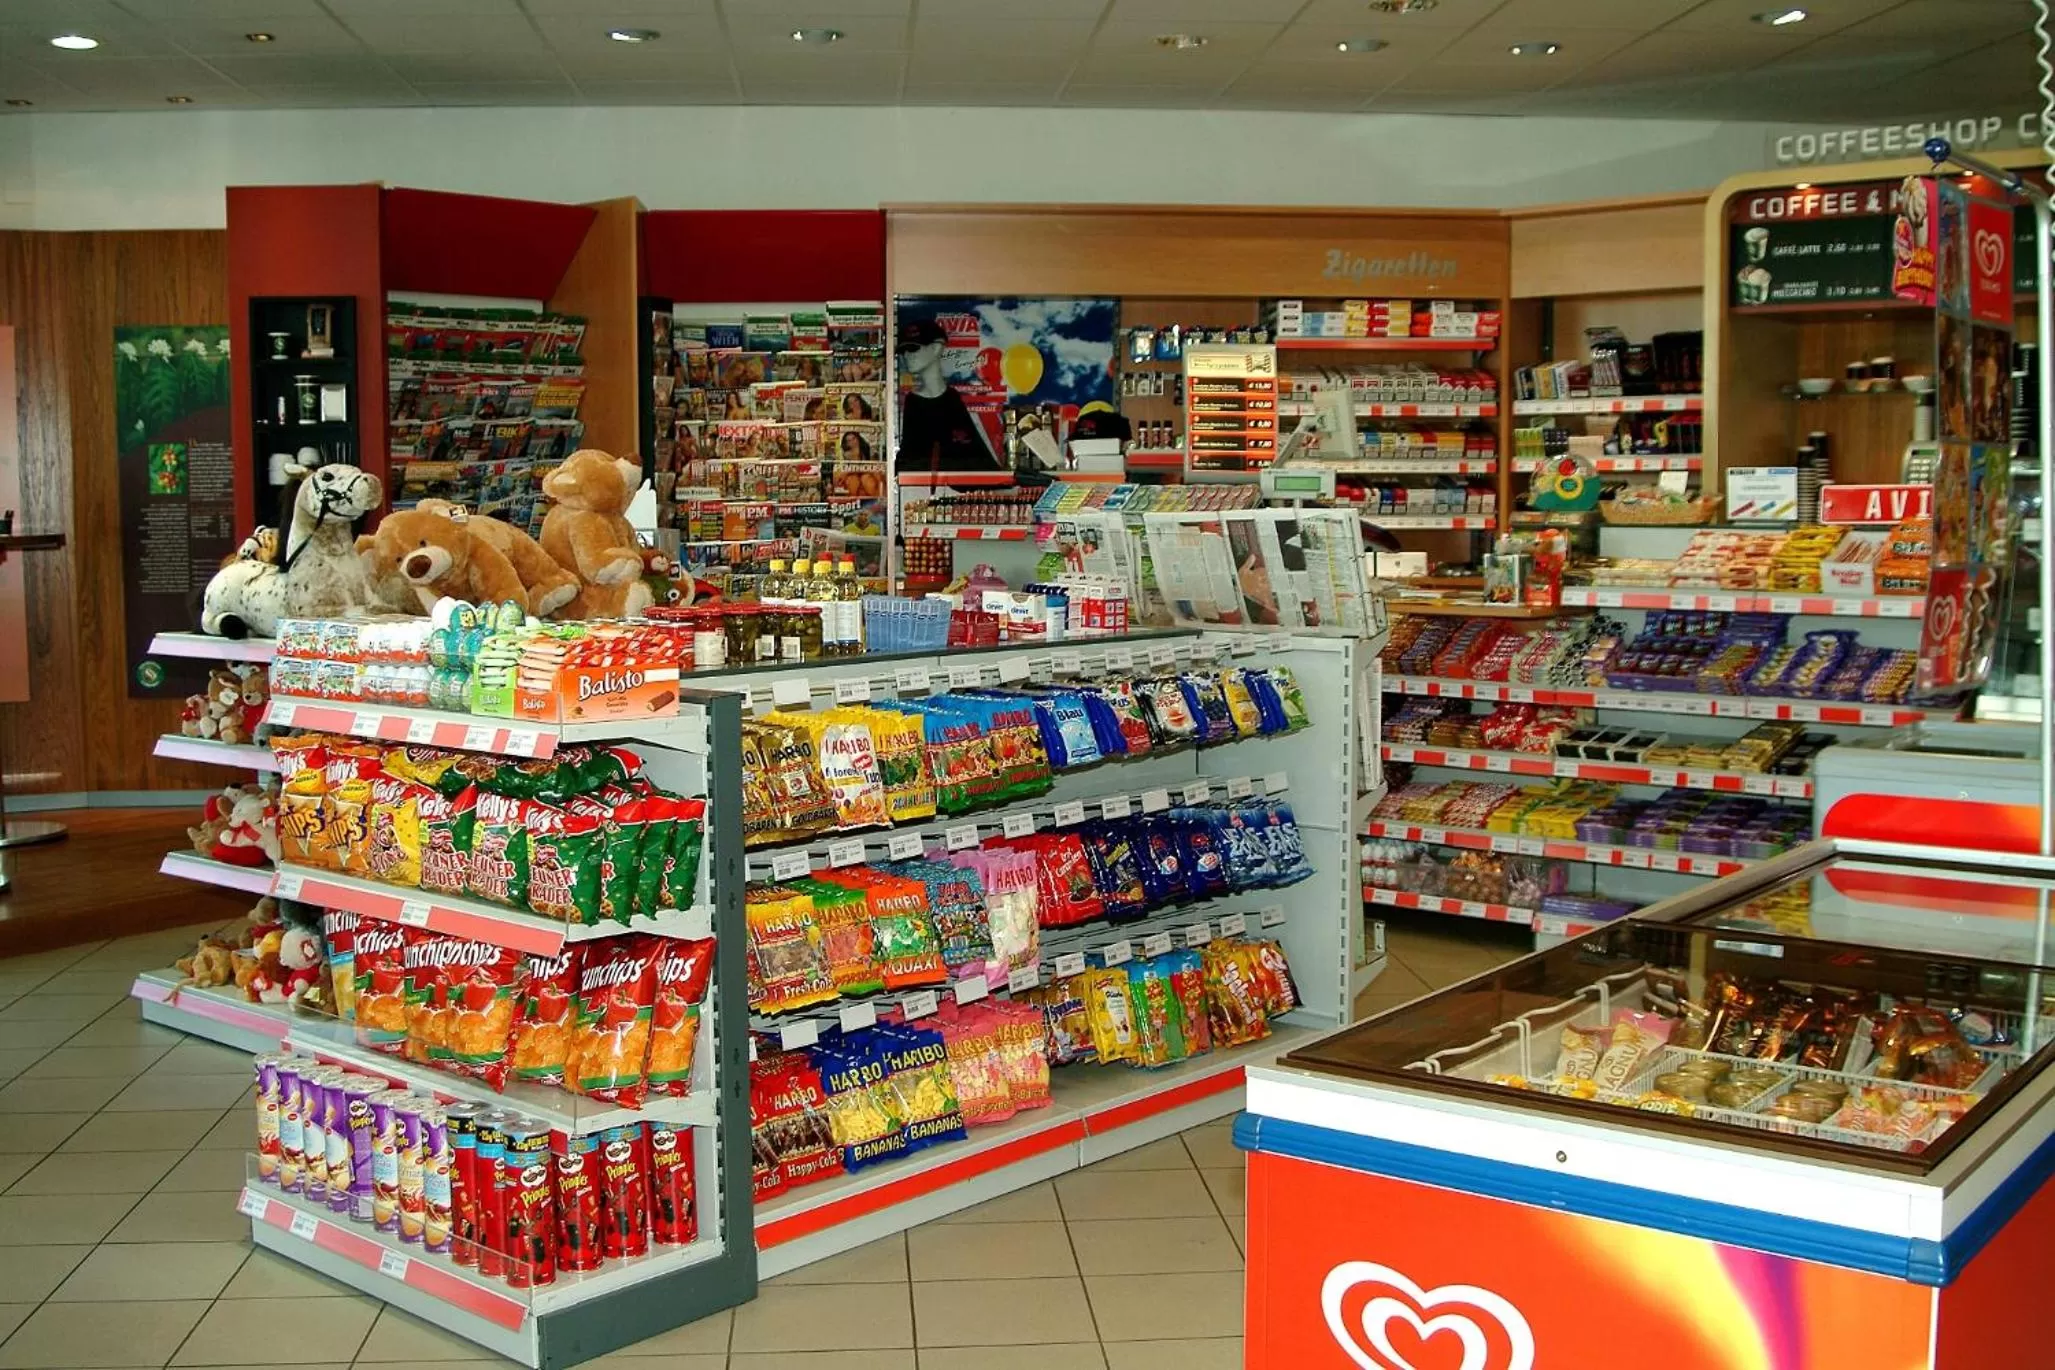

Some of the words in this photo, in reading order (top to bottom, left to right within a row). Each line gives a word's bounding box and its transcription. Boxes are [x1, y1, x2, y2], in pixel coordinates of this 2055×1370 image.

[1776, 116, 2002, 161] COFFEESHOP
[1750, 192, 1858, 220] COFFEE
[578, 669, 644, 702] Balisto
[475, 792, 521, 823] Kelly's
[892, 957, 938, 975] QUAXI
[892, 1043, 945, 1071] HARIBO
[910, 1114, 963, 1140] BANANAS
[653, 1150, 682, 1168] Pringles
[854, 1133, 906, 1161] BANANAS
[559, 1172, 589, 1193] Pringles
[605, 1161, 637, 1182] Pringles
[519, 1183, 550, 1208] Pringles
